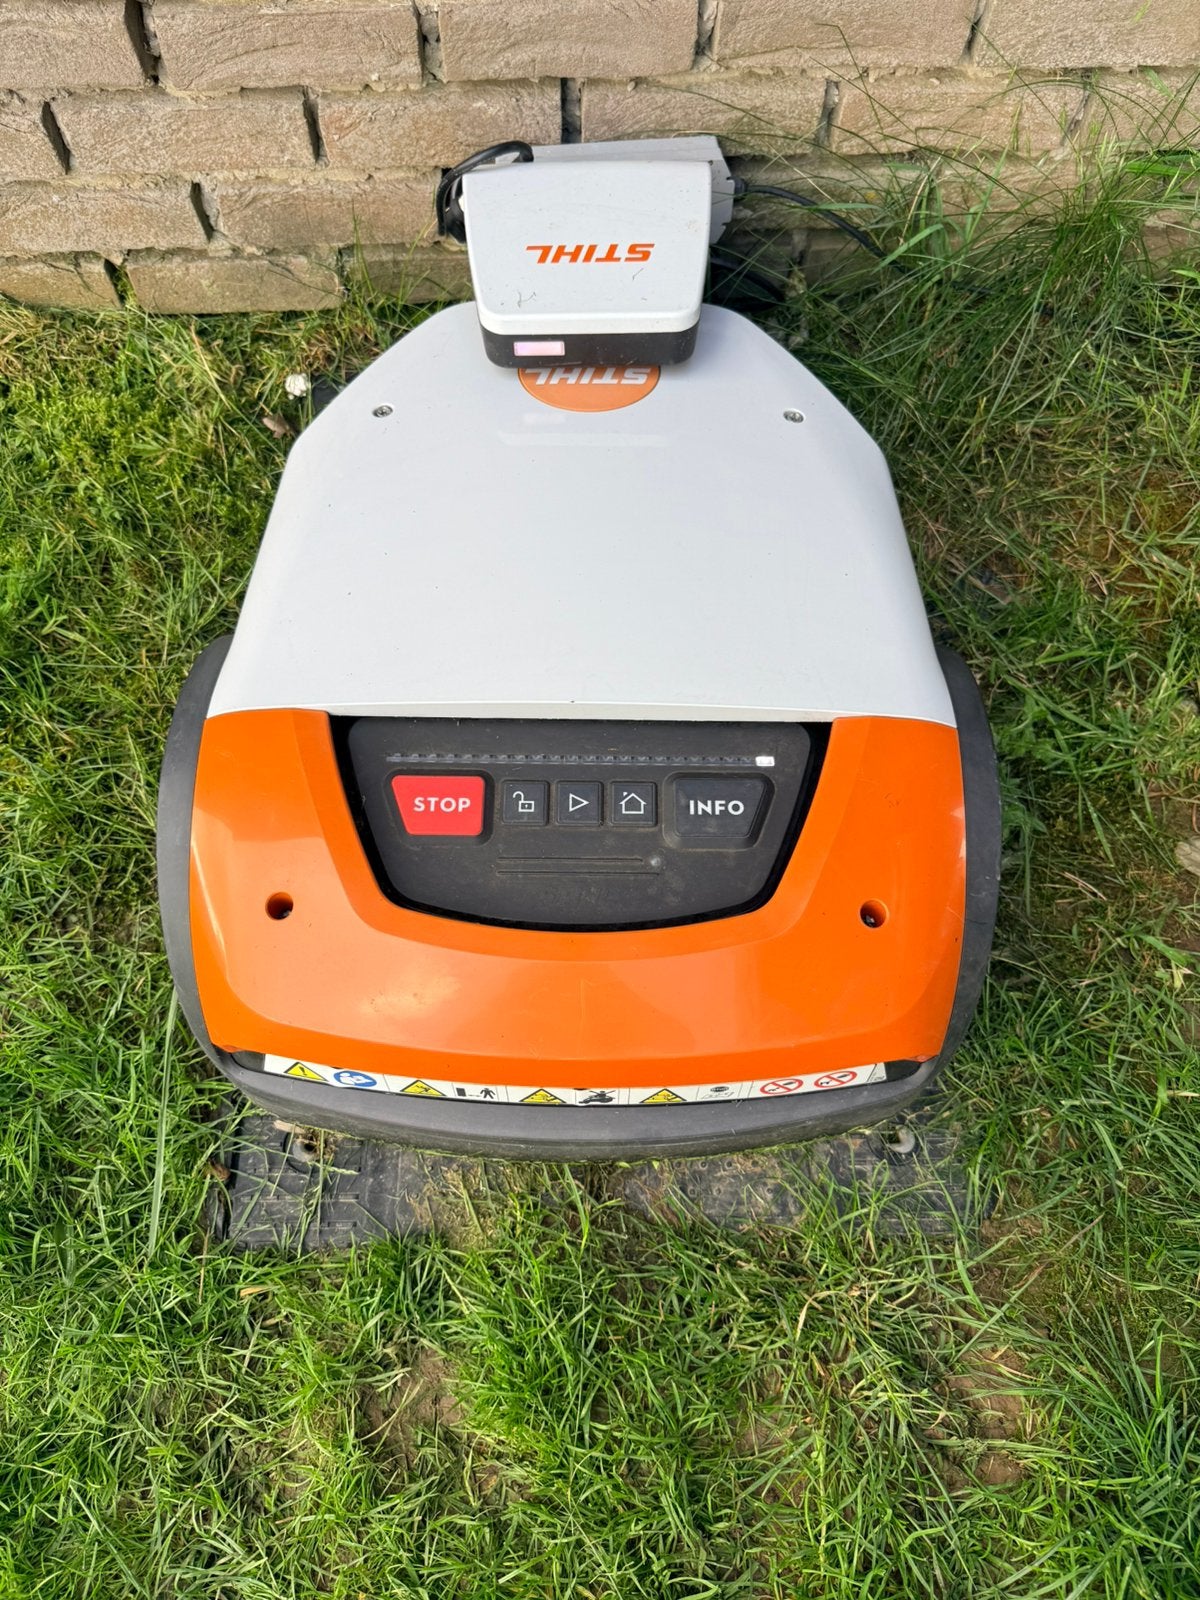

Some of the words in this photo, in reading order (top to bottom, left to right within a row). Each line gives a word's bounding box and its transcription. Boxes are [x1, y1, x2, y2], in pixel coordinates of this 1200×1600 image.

[527, 243, 654, 265] STIHL
[525, 367, 650, 385] STIHL
[413, 796, 471, 813] STOP
[689, 799, 745, 816] INFO
